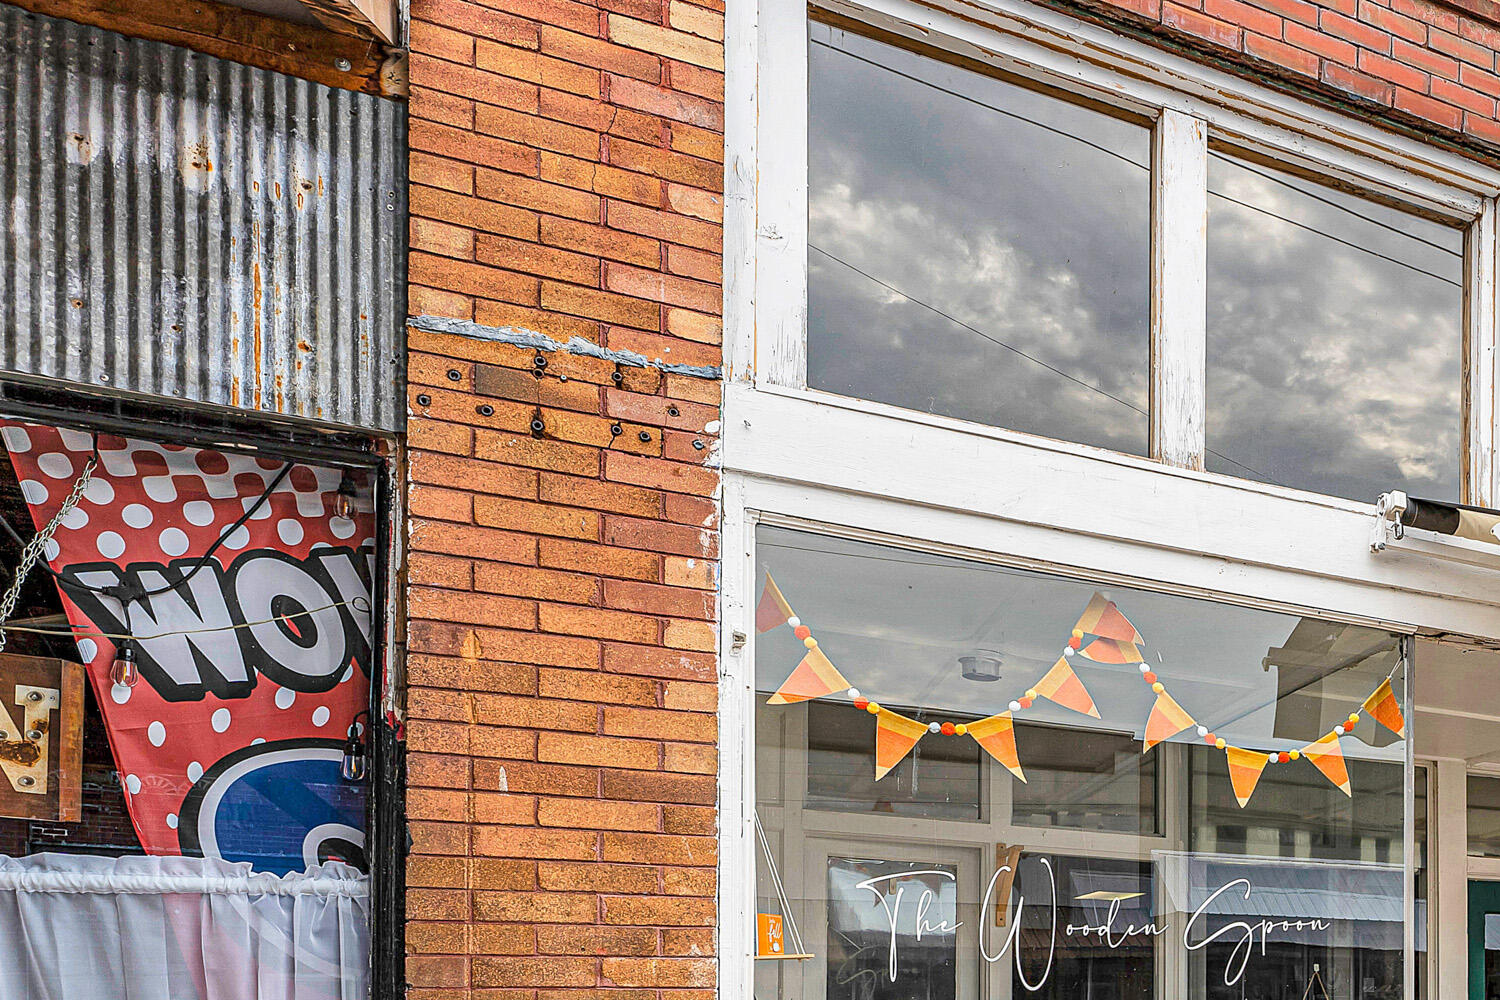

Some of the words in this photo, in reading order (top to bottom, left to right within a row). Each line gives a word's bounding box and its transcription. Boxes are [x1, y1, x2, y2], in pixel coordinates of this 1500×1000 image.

[856, 870, 963, 983] The
[979, 857, 1169, 991] Wooden
[1183, 878, 1331, 986] Spoon
